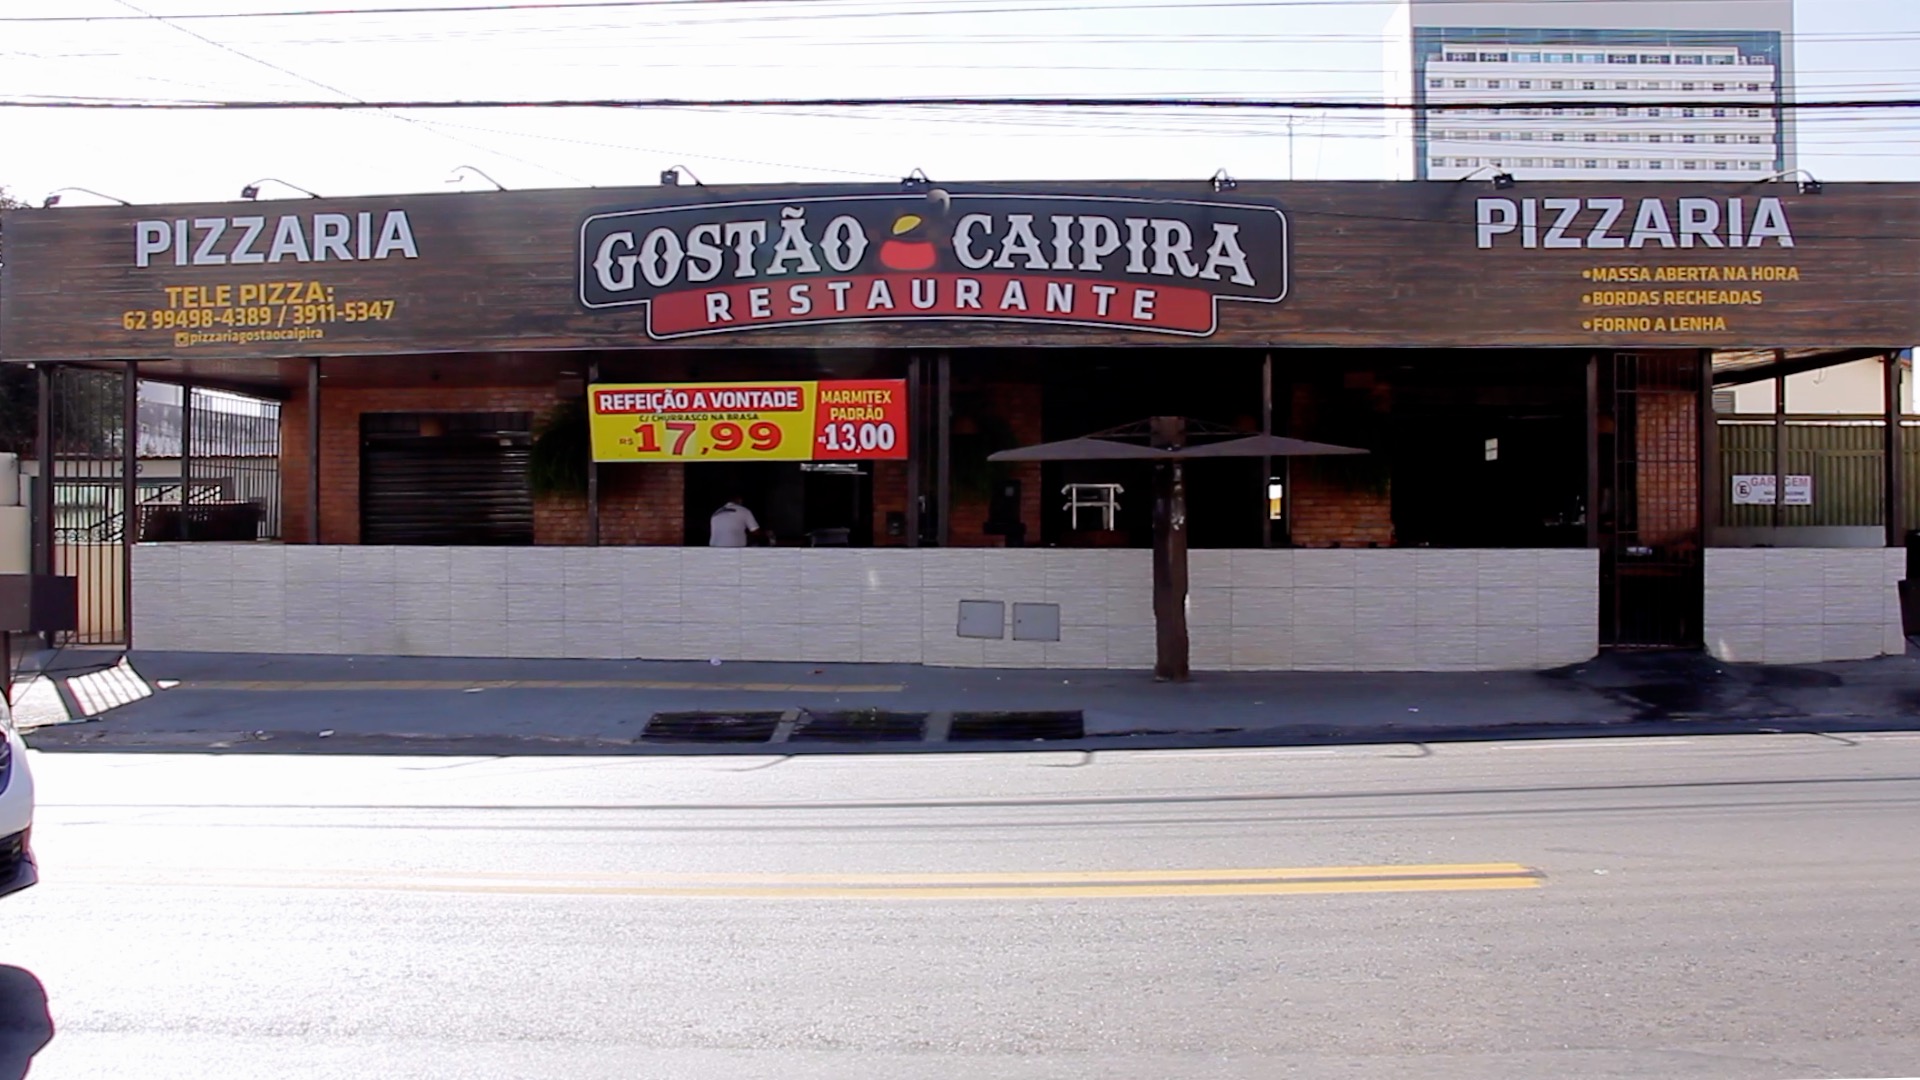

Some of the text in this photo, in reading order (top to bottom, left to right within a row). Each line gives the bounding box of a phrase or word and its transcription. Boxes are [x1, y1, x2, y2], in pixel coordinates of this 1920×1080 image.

[1477, 197, 1794, 249] PIZZARIA
[135, 210, 418, 268] PIZZARIA
[593, 206, 1256, 292] GOSTÃO CAIPIRA
[1592, 266, 1799, 282] MASSA ABERTA NA HORA
[165, 281, 334, 309] TELE PIZZA:
[706, 279, 1157, 323] RESTAURANTE
[1592, 290, 1762, 306] BORDAS RECHEADAS
[123, 301, 395, 330] 62 99498-4389 / 3911-5347
[1593, 317, 1726, 332] FORNO A LENHA
[600, 389, 798, 413] REFEIÇÃO A VONTADE
[821, 390, 892, 404] MARMITEX
[652, 413, 708, 422] CHURRASCO
[711, 413, 725, 421] NA
[727, 413, 759, 421] BRASA
[830, 404, 884, 421] PADRÃO
[634, 421, 782, 456] 17,99
[824, 423, 895, 454] 13,00
[1751, 476, 1808, 487] GARGEM
